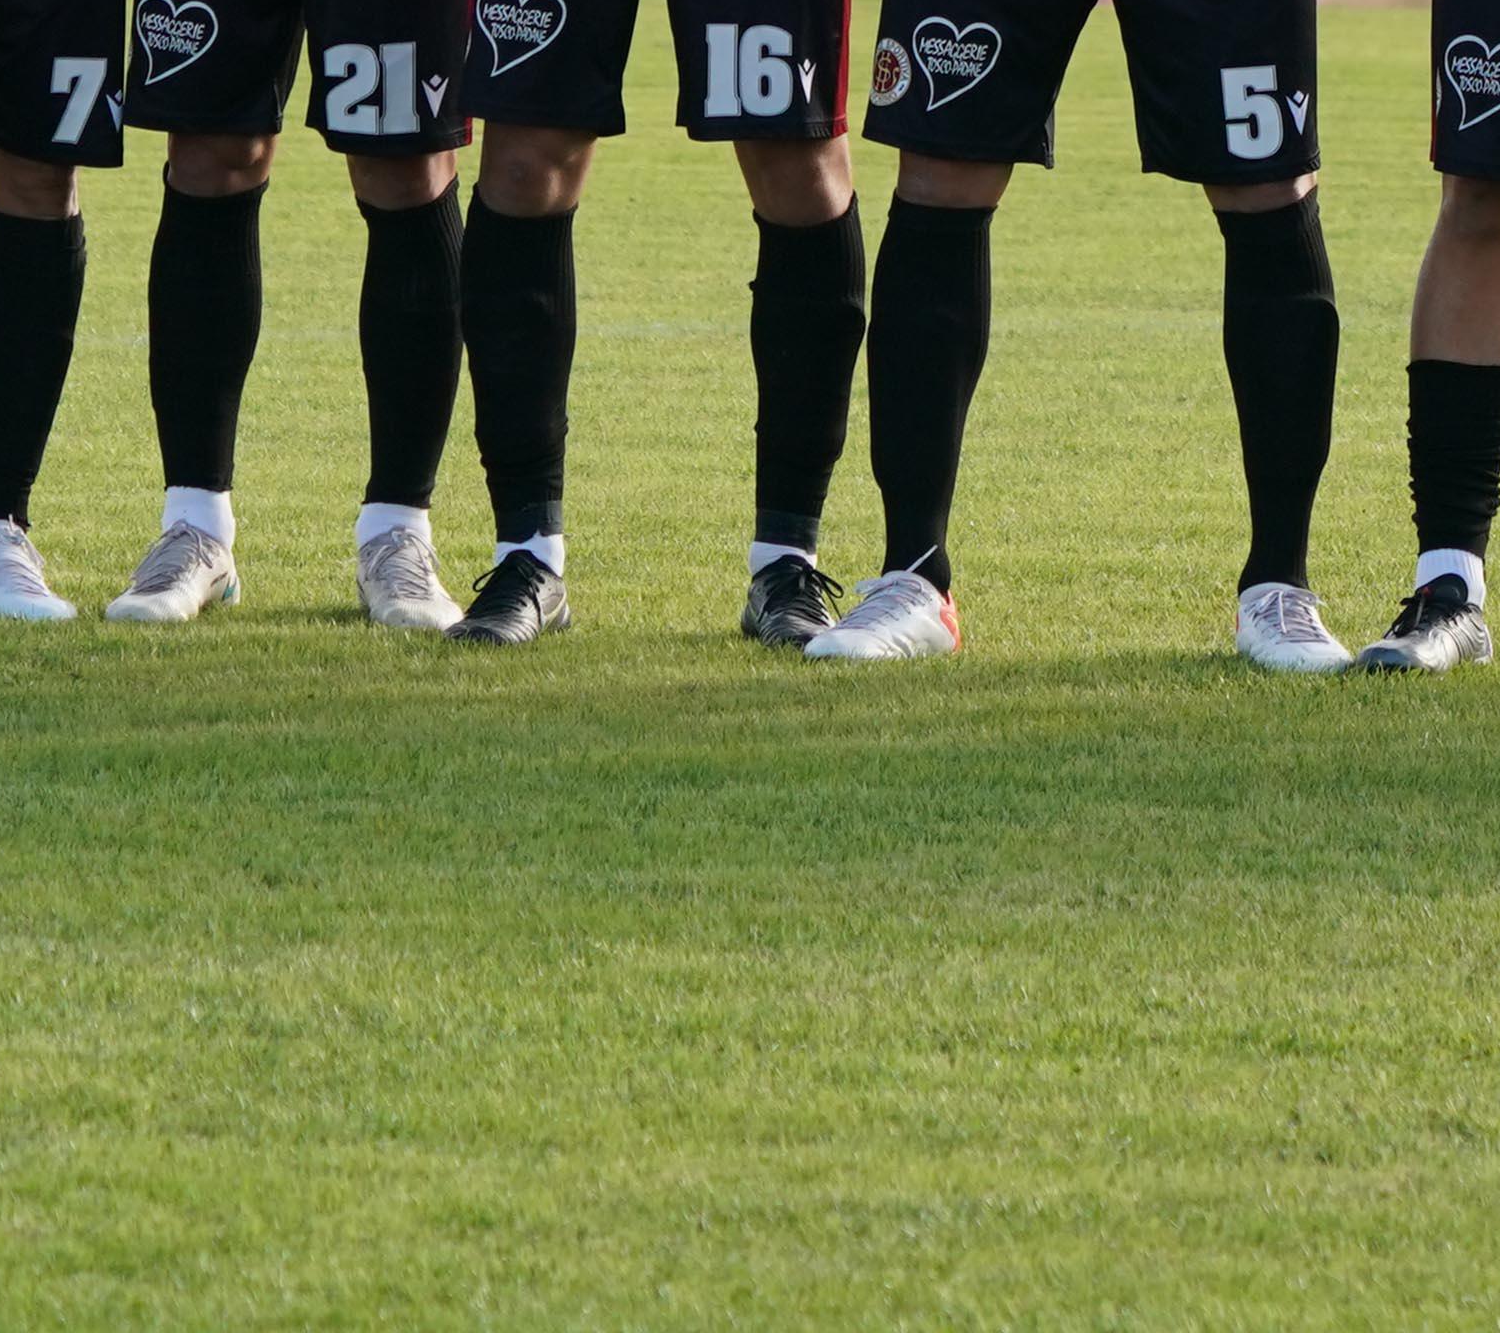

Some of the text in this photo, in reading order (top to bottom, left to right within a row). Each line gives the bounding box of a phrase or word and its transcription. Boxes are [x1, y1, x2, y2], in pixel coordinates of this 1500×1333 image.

[48, 56, 109, 146] 7
[323, 40, 422, 136] 21
[702, 21, 795, 119] 16
[1219, 63, 1284, 161] 5
